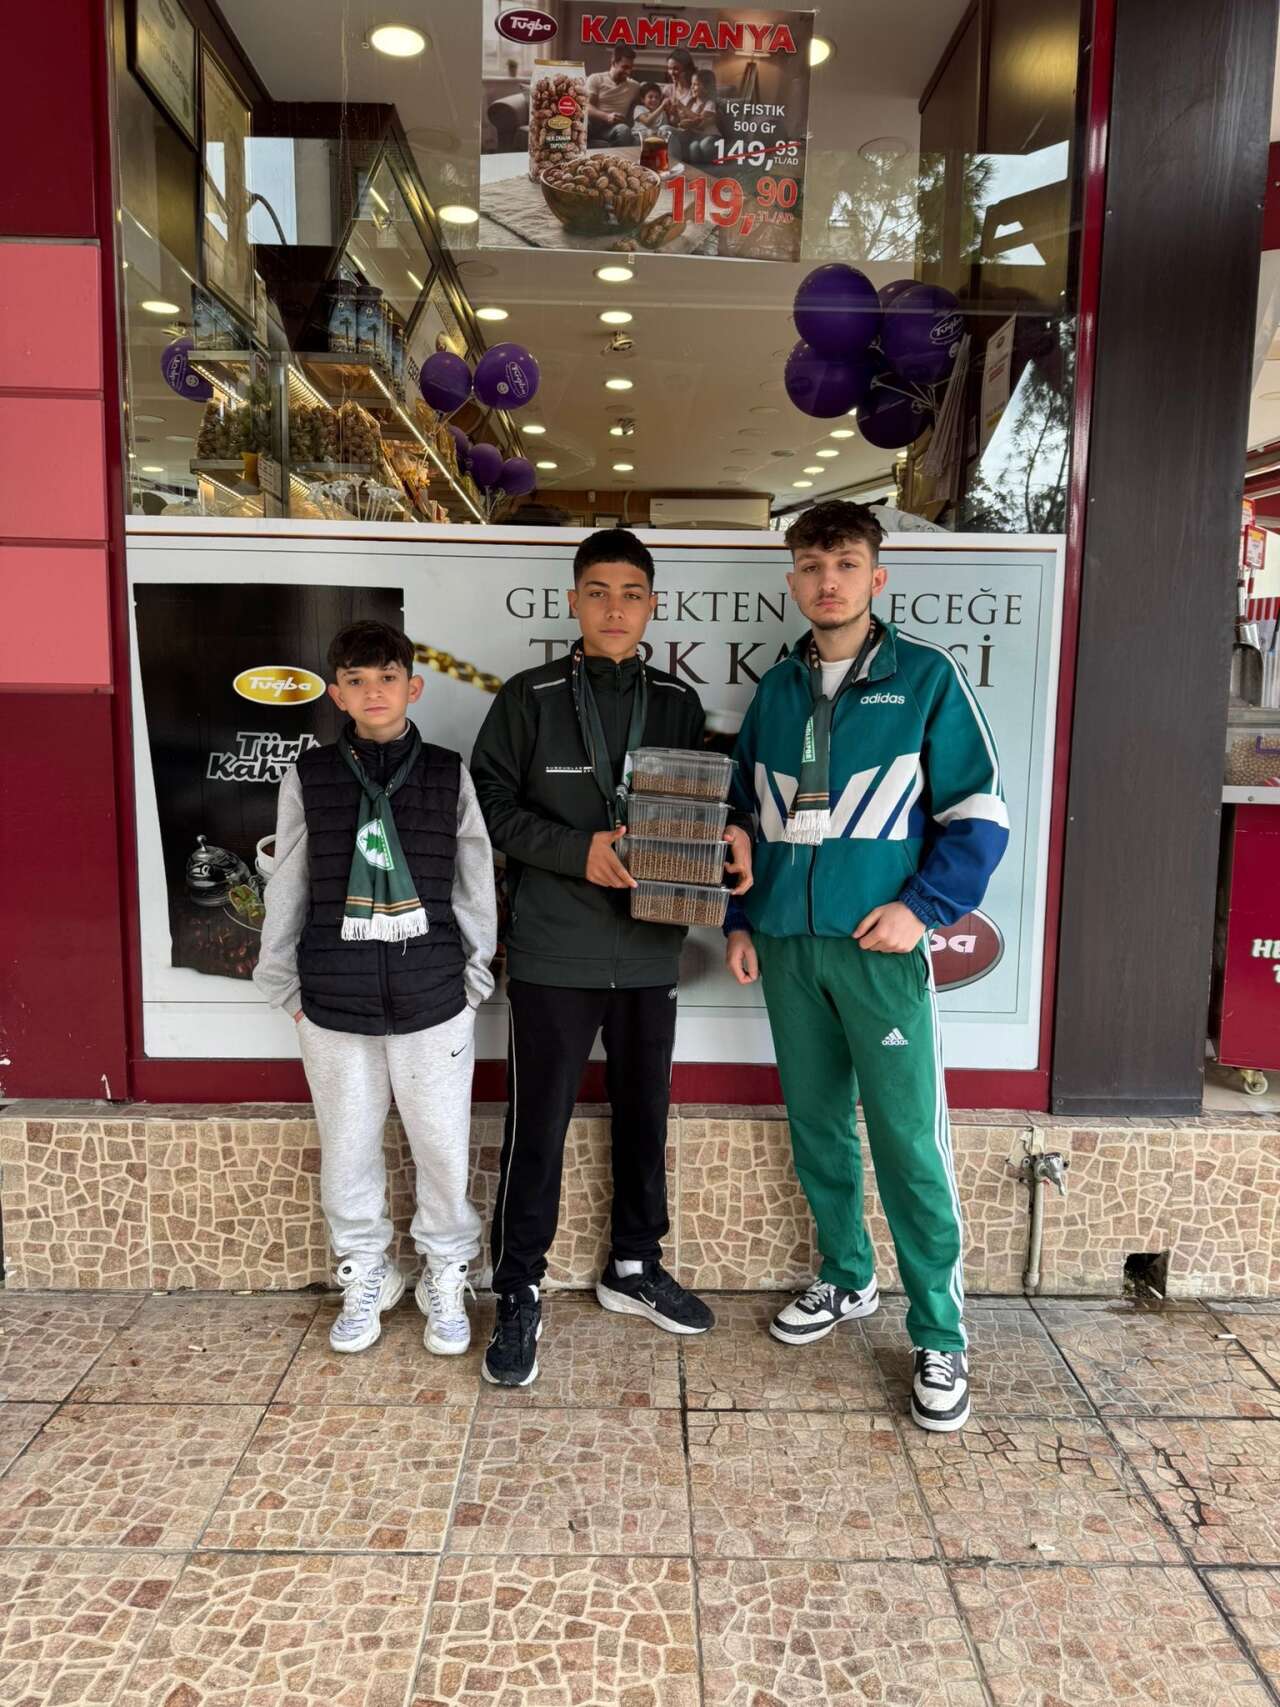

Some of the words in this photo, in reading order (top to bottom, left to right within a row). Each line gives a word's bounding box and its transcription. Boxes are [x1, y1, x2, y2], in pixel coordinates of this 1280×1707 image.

[581, 15, 797, 53] KAMPANYA
[725, 101, 740, 118] İÇ
[743, 103, 785, 117] FISTIK
[733, 121, 757, 133] 500
[760, 122, 776, 133] Gr
[774, 156, 799, 166] TL/AD
[506, 587, 787, 624] GEEKTEN
[889, 587, 1022, 625] ECEĞE
[860, 692, 906, 705] adidas
